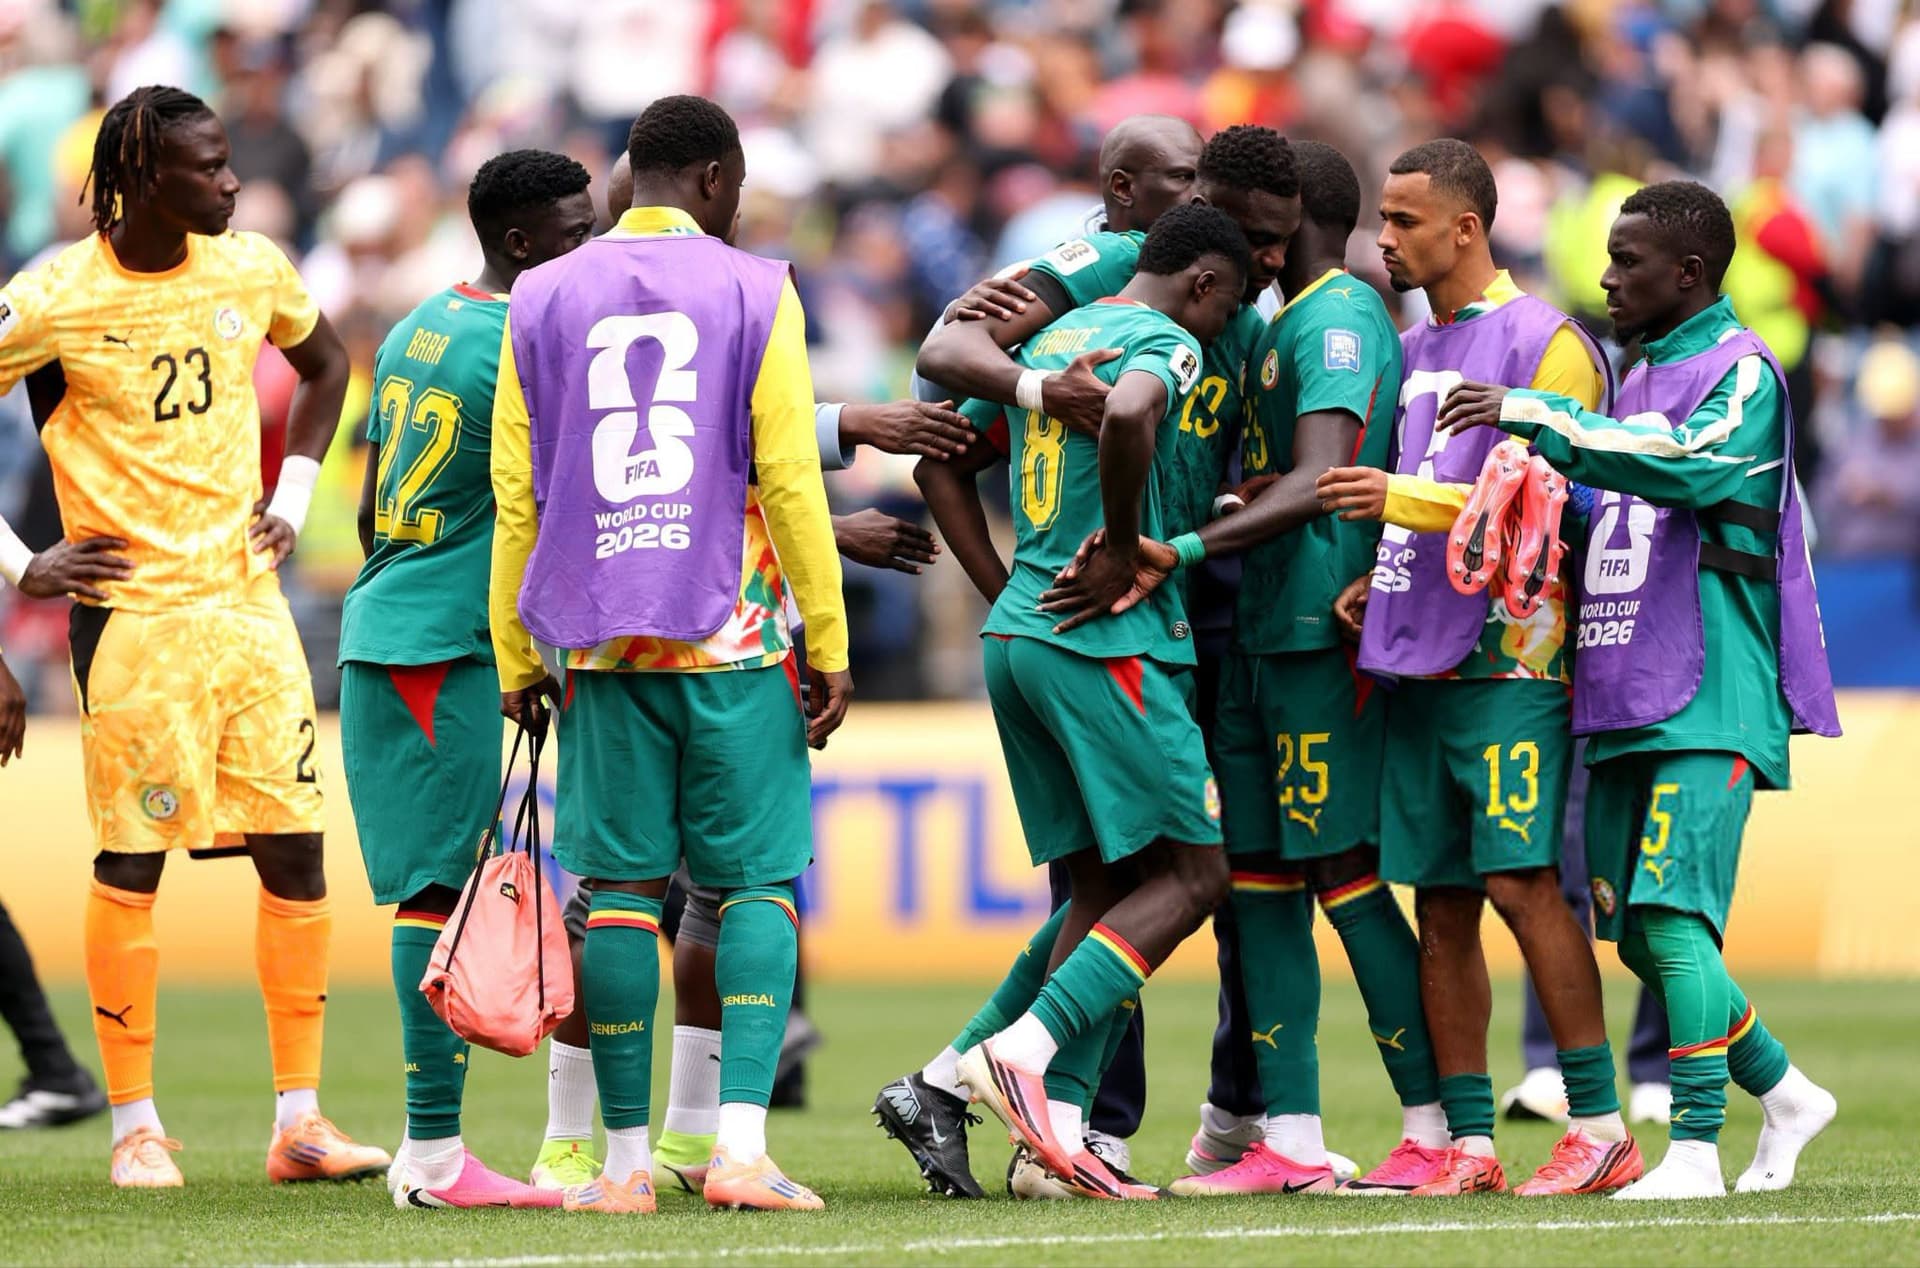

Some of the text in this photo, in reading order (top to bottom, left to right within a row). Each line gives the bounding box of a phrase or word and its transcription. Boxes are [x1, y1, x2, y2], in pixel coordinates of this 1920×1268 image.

[406, 328, 450, 365] BARA
[152, 347, 212, 422] 23
[375, 375, 463, 546] 22
[625, 459, 661, 485] FIFA
[1021, 408, 1069, 531] 8
[595, 503, 692, 529] WORLD CUP
[596, 523, 691, 559] 2026
[1599, 558, 1630, 577] FIFA
[1579, 600, 1641, 620] WORLD CUP
[1576, 619, 1635, 650] 2026
[296, 718, 317, 783] 2
[1277, 732, 1330, 806] 25
[1483, 741, 1539, 816] 13
[1640, 783, 1679, 856] 5
[723, 994, 776, 1007] SENEGAL
[591, 1020, 645, 1036] SENEGAL
